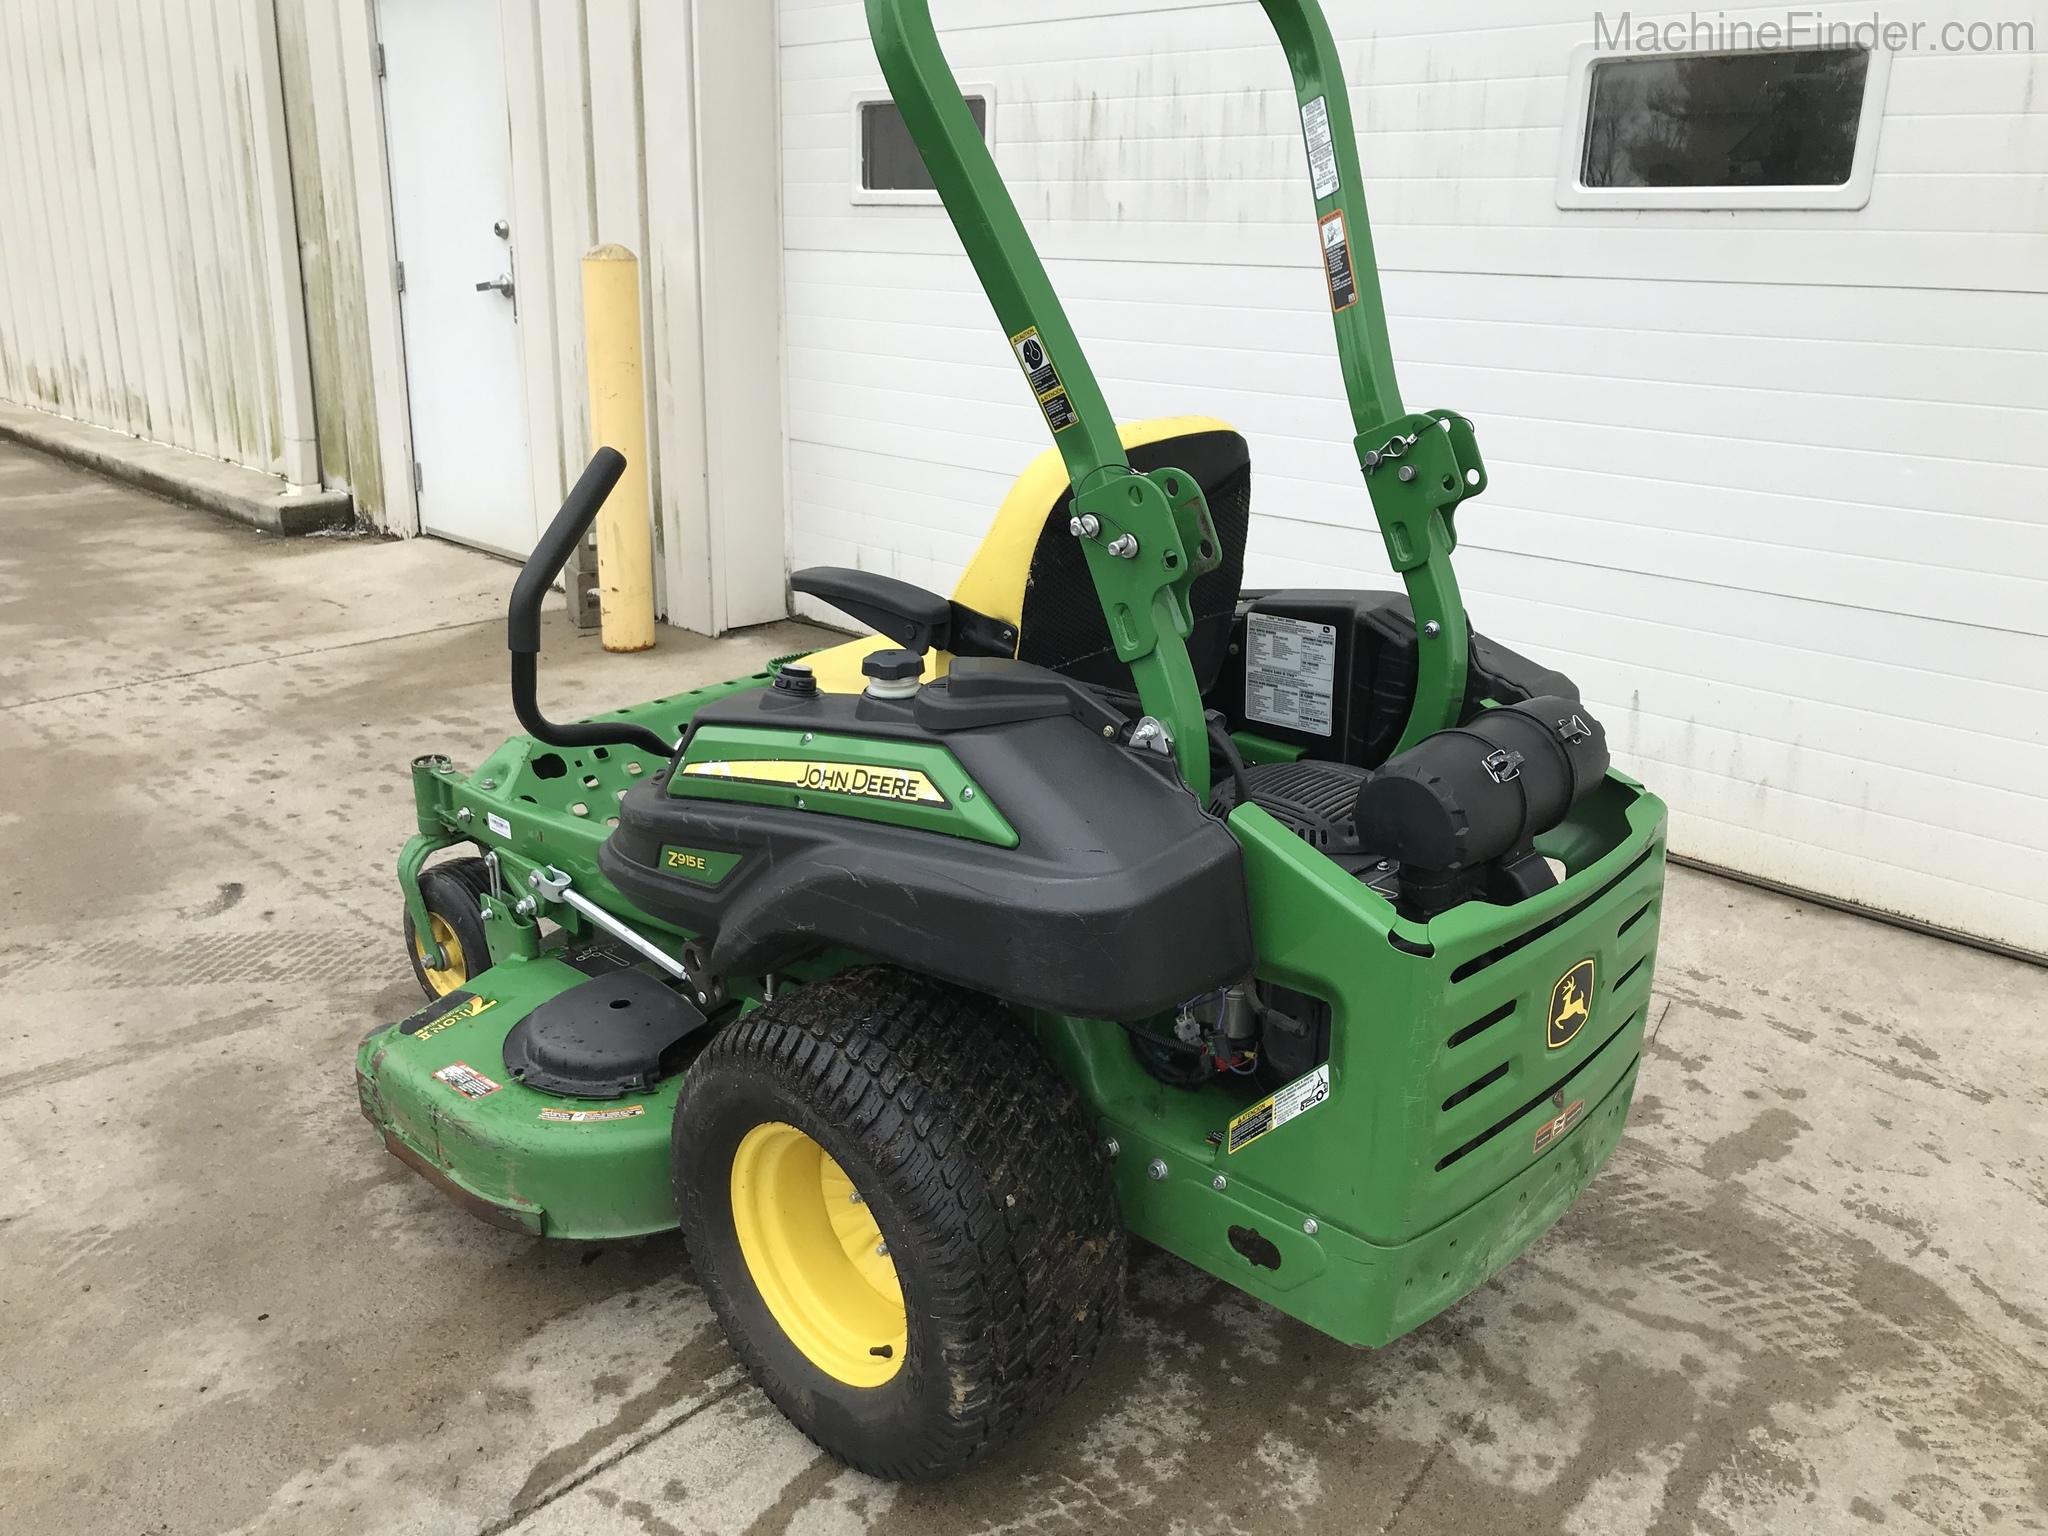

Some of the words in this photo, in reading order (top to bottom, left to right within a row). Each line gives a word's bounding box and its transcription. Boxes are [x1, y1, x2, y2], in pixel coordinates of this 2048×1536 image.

[1016, 329, 1035, 340] CAUTION
[797, 763, 850, 791] JOHN
[852, 769, 920, 798] DEERE
[667, 850, 706, 870] Z915E
